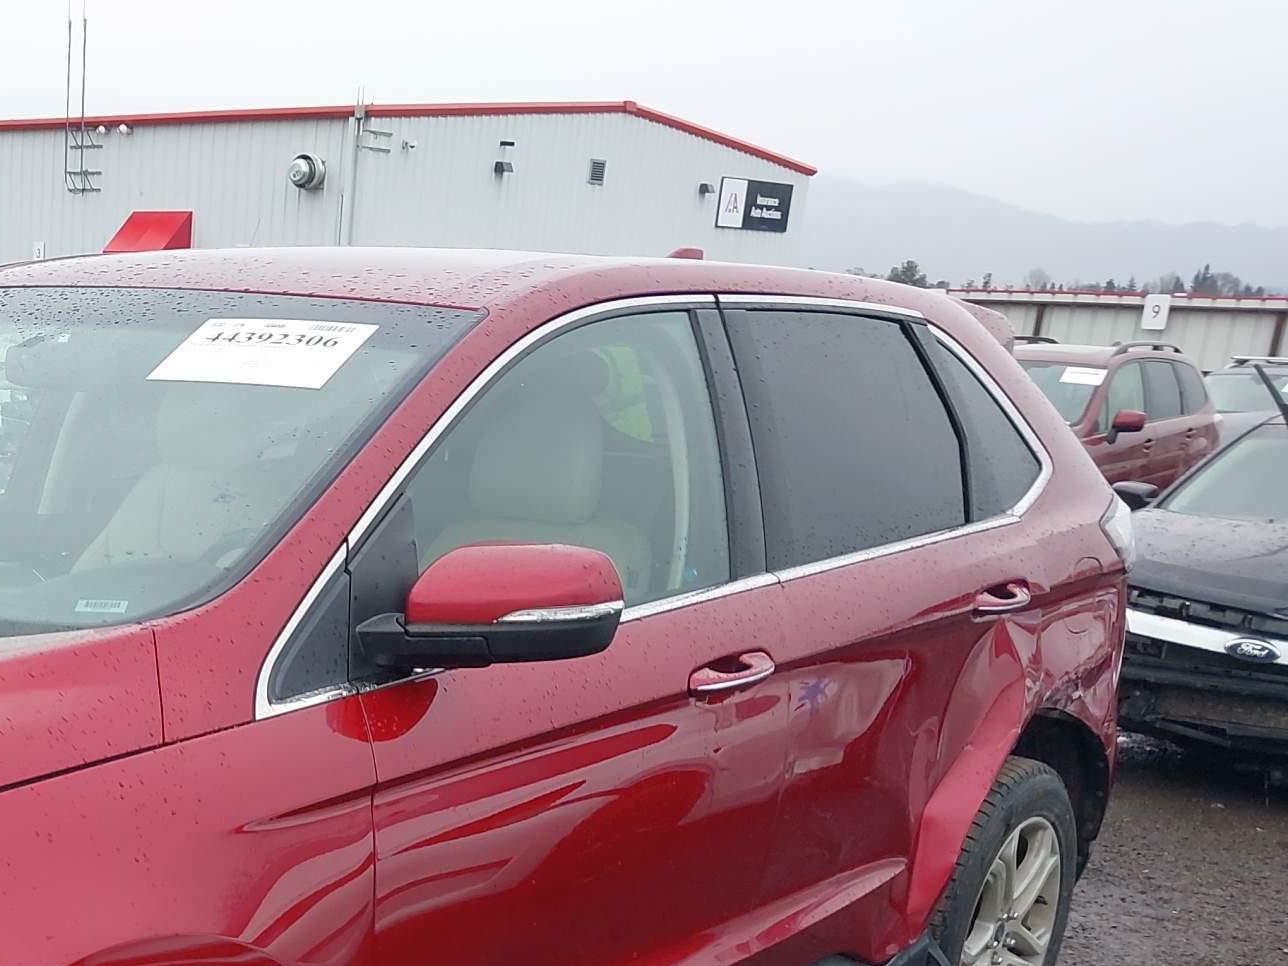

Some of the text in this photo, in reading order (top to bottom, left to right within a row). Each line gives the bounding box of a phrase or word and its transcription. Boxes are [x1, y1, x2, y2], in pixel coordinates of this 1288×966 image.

[36, 247, 41, 258] 3
[1152, 304, 1160, 319] 9
[206, 331, 342, 348] 44392306
[1236, 642, 1270, 658] Ford
